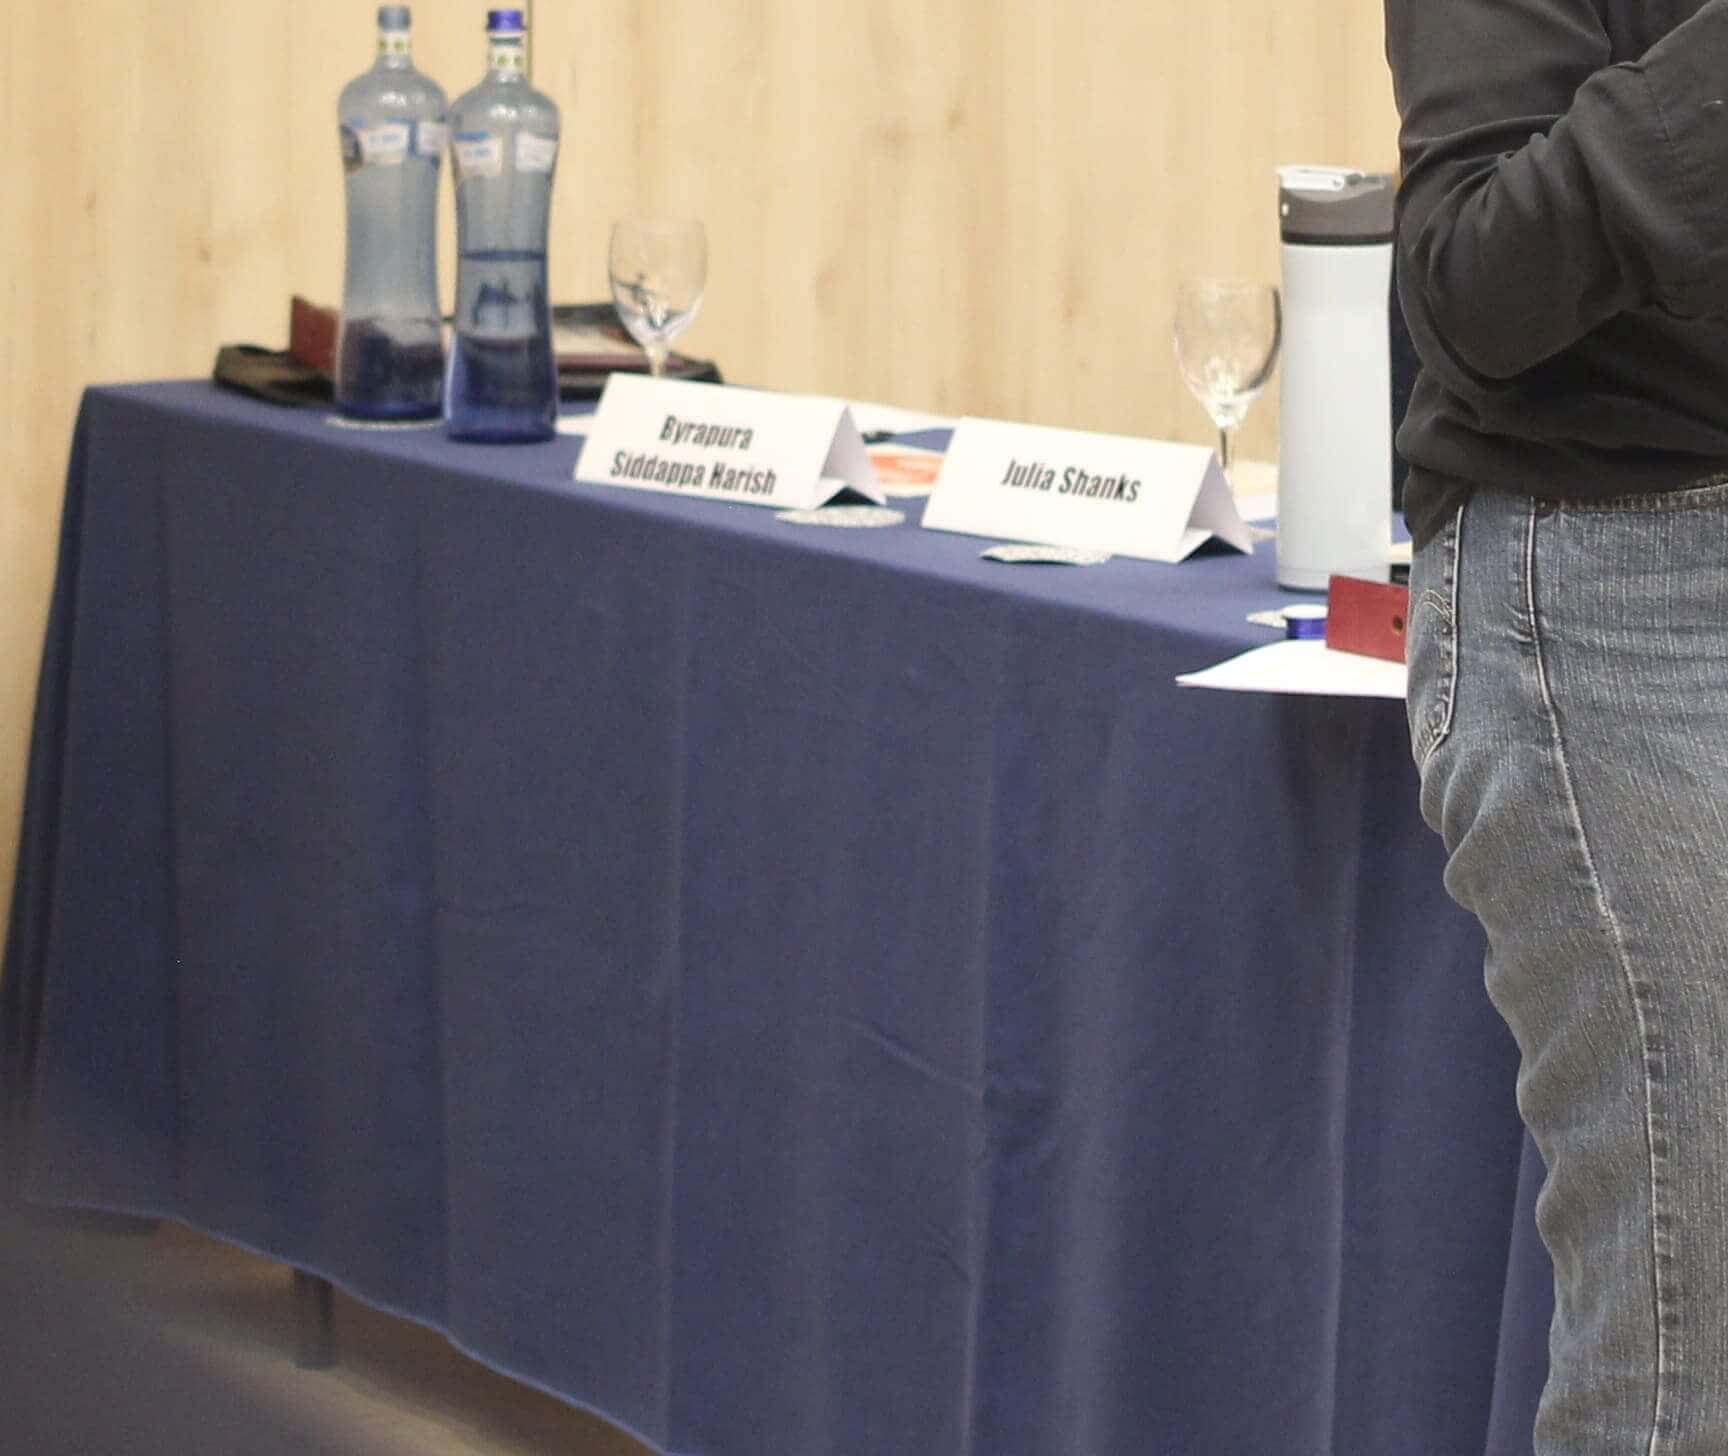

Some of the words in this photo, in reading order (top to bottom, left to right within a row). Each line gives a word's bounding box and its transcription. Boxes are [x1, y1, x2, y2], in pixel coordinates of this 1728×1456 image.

[659, 414, 754, 450] Byrapura
[610, 450, 706, 487] Siddappa
[709, 462, 777, 496] Harish
[1001, 458, 1056, 491] Julia
[1058, 466, 1142, 502] Shanks
